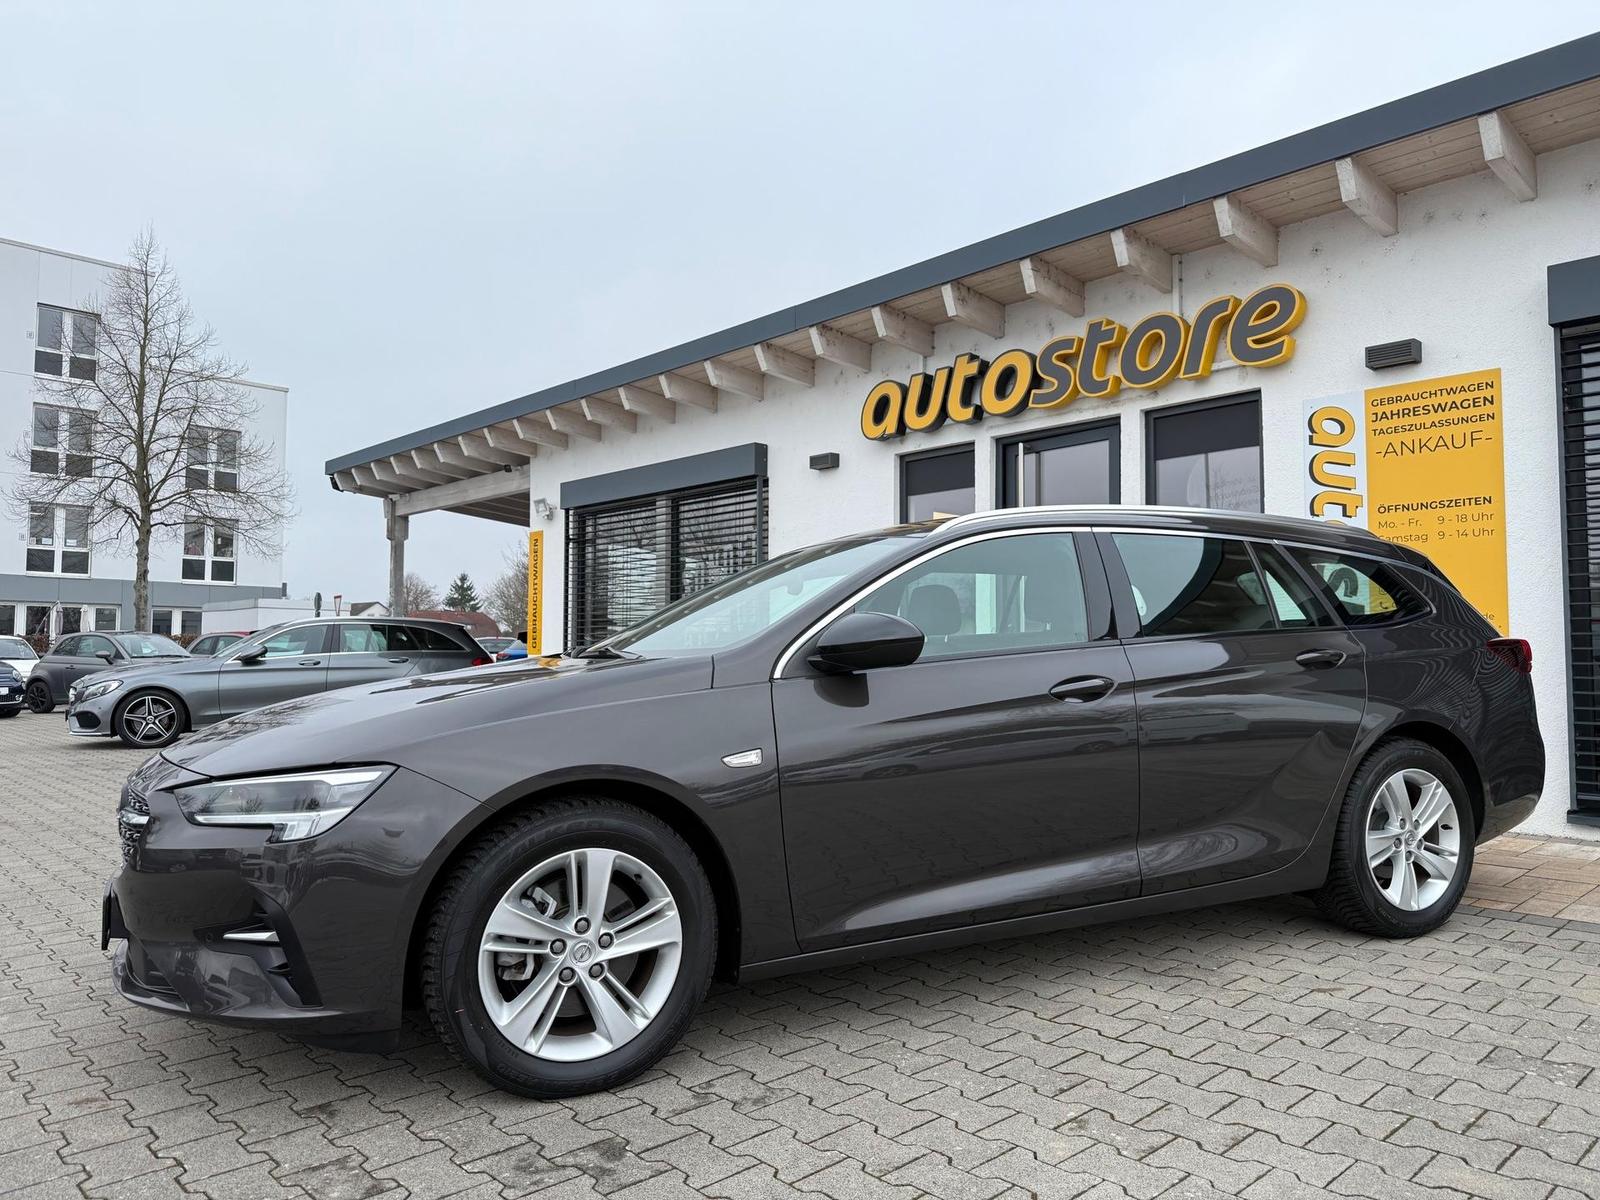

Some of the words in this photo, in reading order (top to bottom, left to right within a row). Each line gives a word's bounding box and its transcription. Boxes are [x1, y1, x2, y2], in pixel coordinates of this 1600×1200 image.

[860, 282, 1307, 441] autostore
[1371, 381, 1495, 407] GEBRAUCHTWAGEN
[1371, 395, 1495, 423] JAHRESWAGEN
[1371, 412, 1495, 437] TAGESZULASSUNGEN
[1376, 430, 1493, 458] -ANKAUF-
[1377, 496, 1492, 514] ÖFFNUNGSZEITEN
[1378, 520, 1398, 529] Mo.
[1408, 518, 1422, 527] Fr.
[1437, 515, 1445, 525] 9
[1456, 513, 1468, 524] 18
[1471, 512, 1495, 522] Uhr
[1437, 530, 1445, 540] 9
[1456, 529, 1468, 539] 14
[1472, 527, 1495, 538] Uhr
